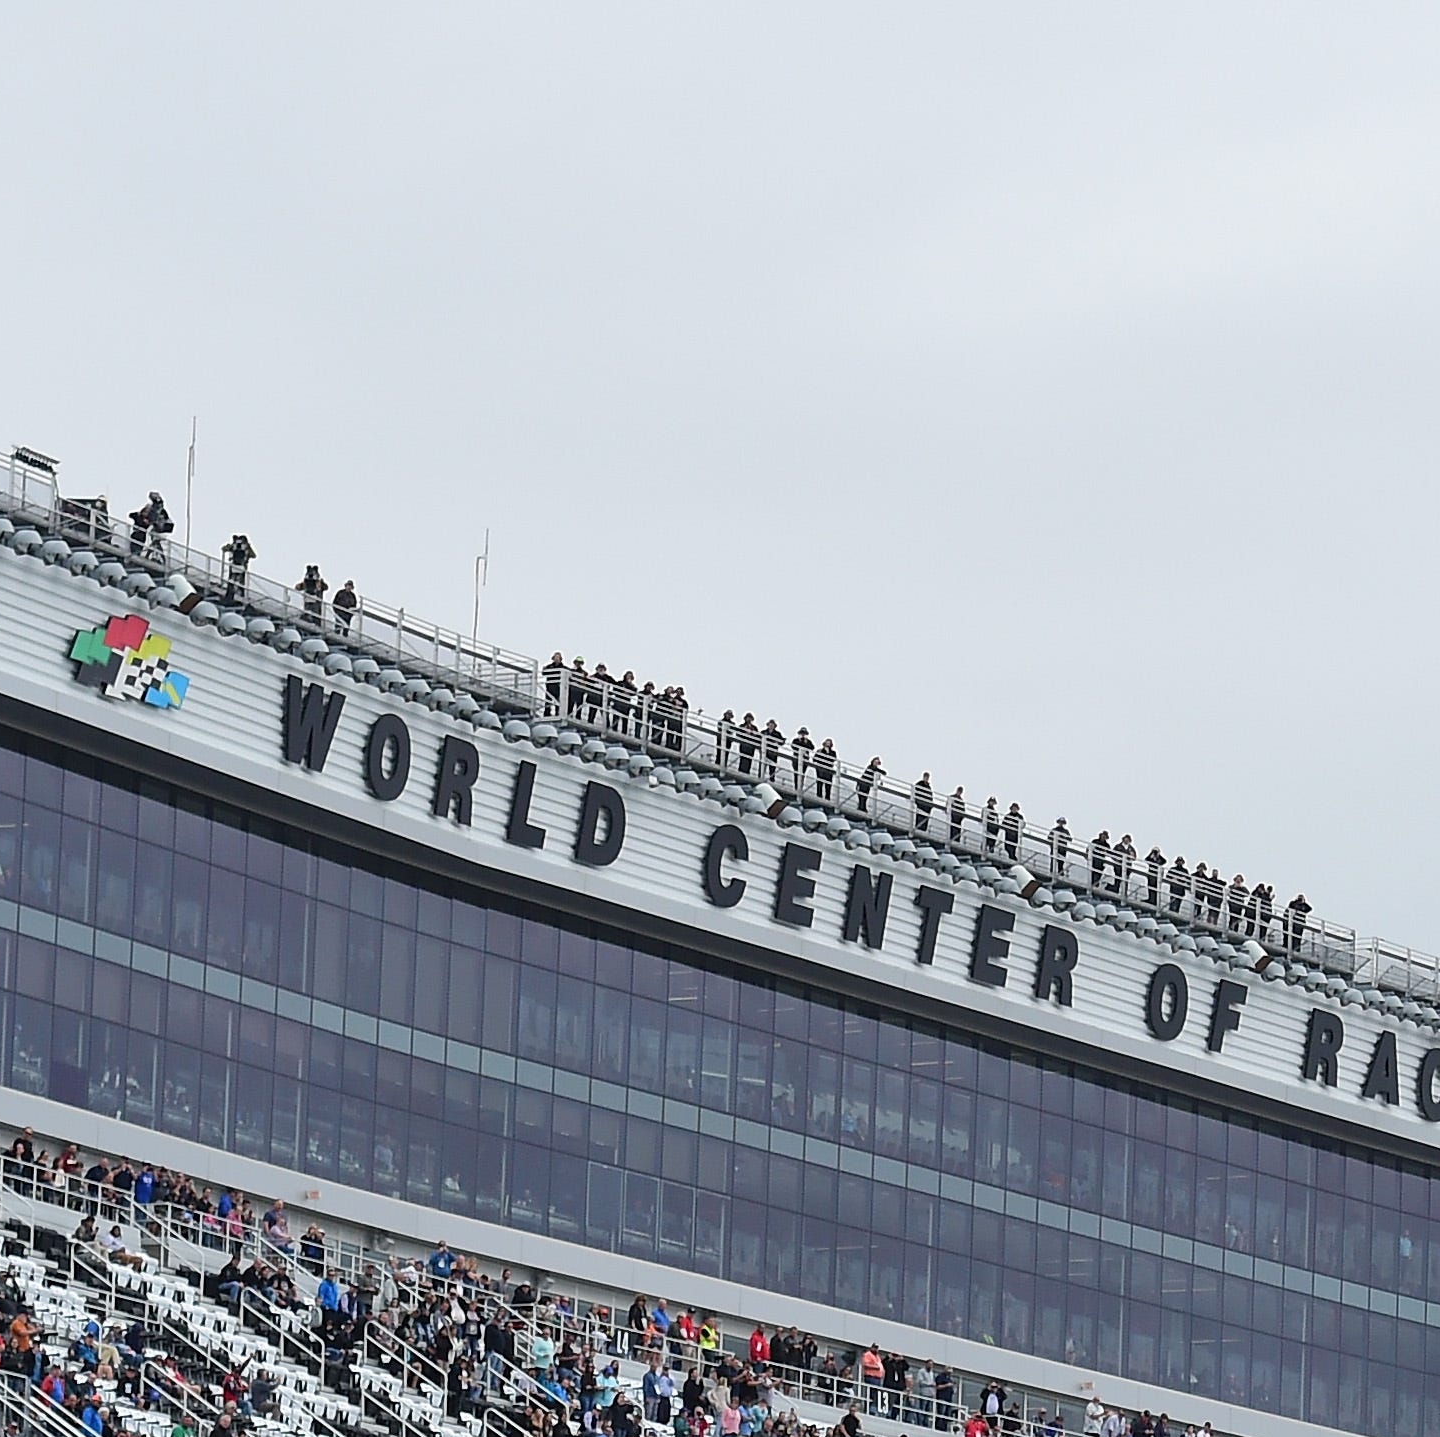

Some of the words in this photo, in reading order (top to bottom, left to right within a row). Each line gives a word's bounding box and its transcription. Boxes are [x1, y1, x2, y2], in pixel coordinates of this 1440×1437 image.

[282, 673, 627, 868] WORLD
[703, 823, 1079, 1009] CENTER
[1145, 962, 1249, 1054] OF
